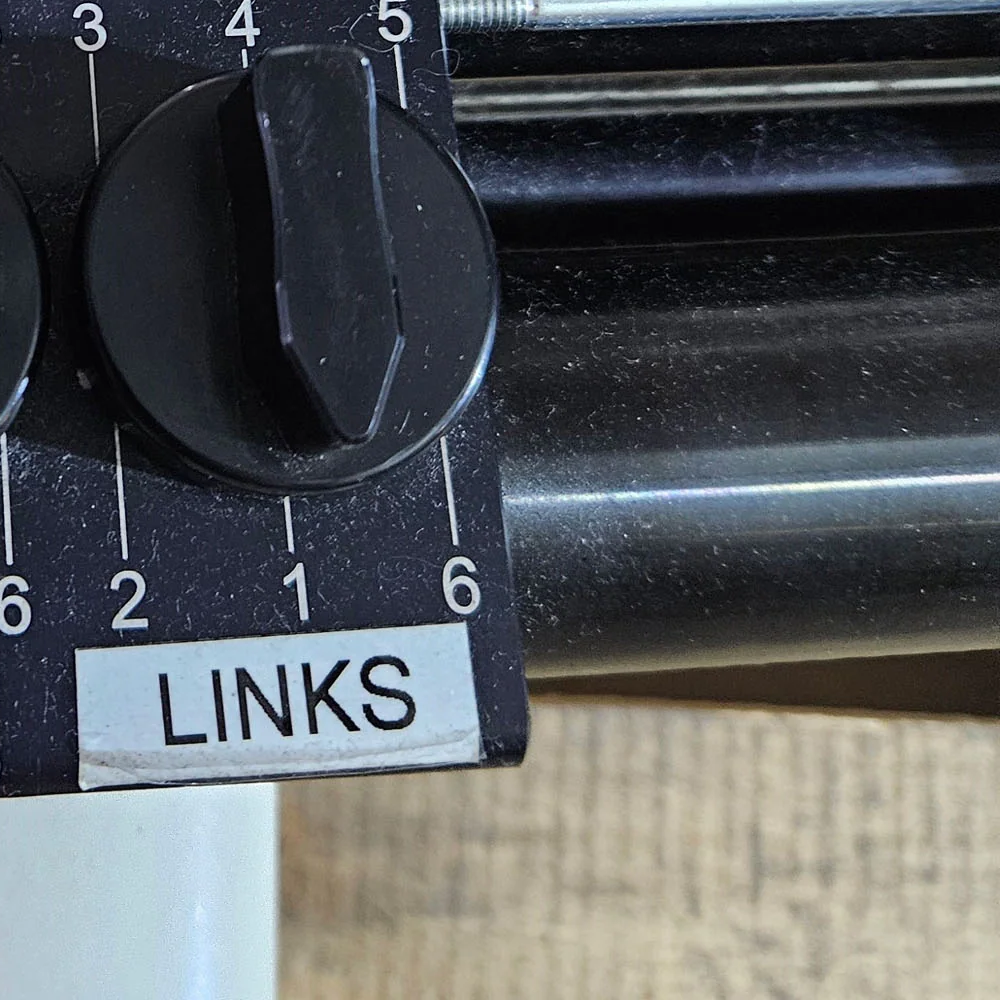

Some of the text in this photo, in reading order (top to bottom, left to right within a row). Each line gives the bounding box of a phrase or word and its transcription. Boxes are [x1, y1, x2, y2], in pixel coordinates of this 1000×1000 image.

[72, 2, 107, 52] 3
[110, 556, 481, 630] 2 1 6
[158, 655, 417, 746] LINKS
